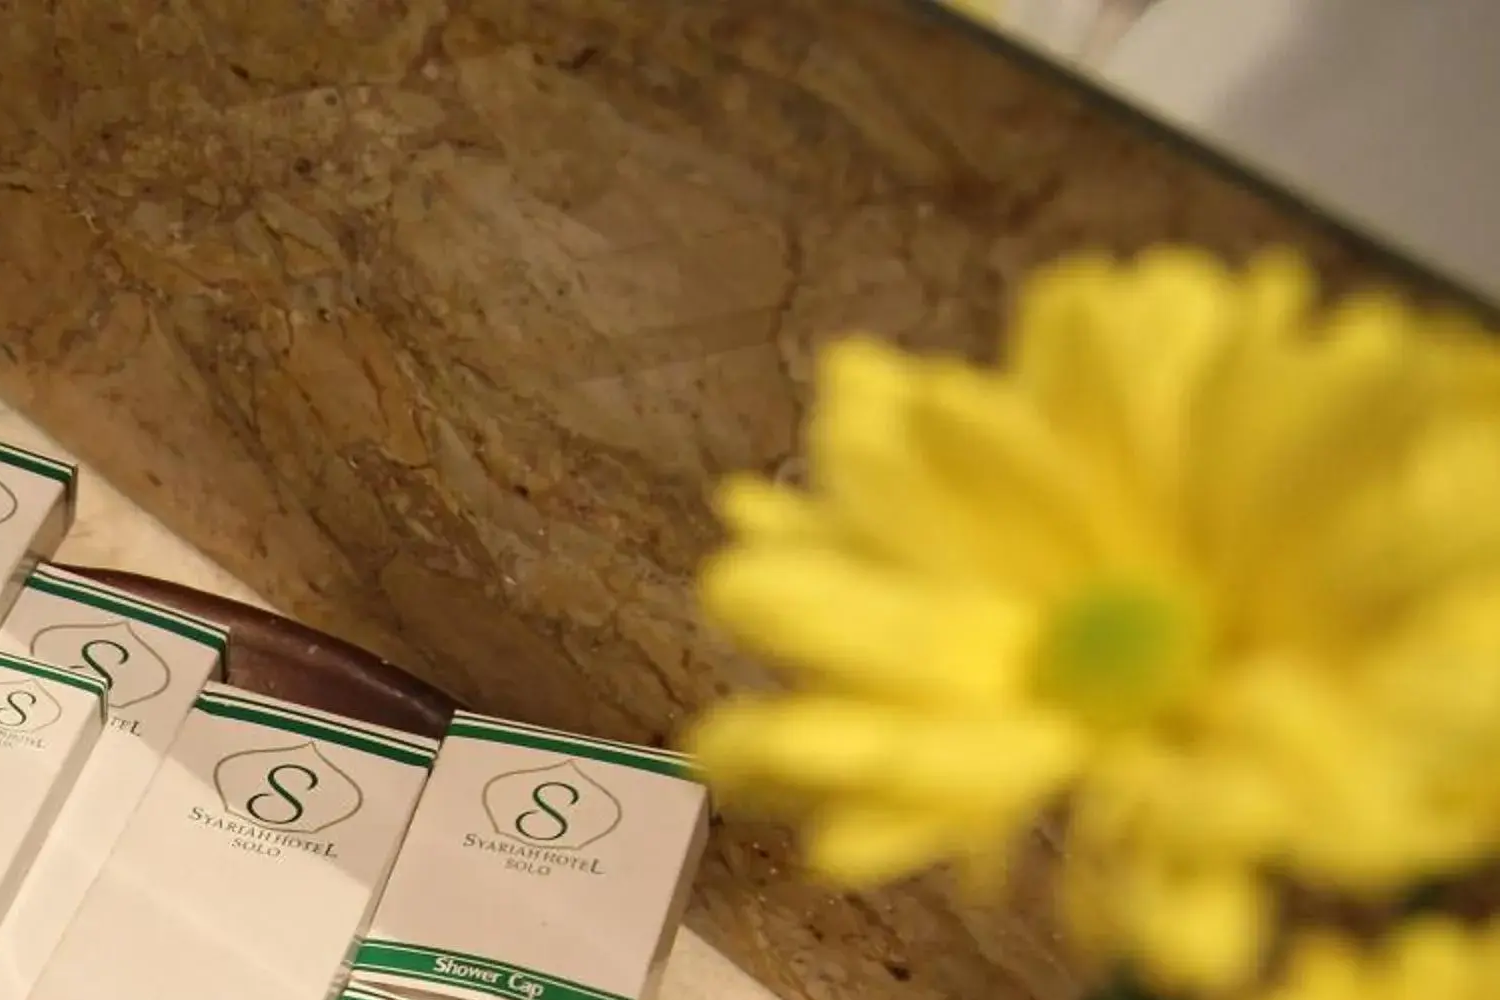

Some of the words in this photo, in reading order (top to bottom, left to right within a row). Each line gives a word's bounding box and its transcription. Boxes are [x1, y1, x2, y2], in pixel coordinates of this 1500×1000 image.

[230, 837, 281, 858] SOLO
[504, 857, 552, 876] SOLO
[432, 955, 504, 984] Shower
[508, 971, 545, 1000] Cap
